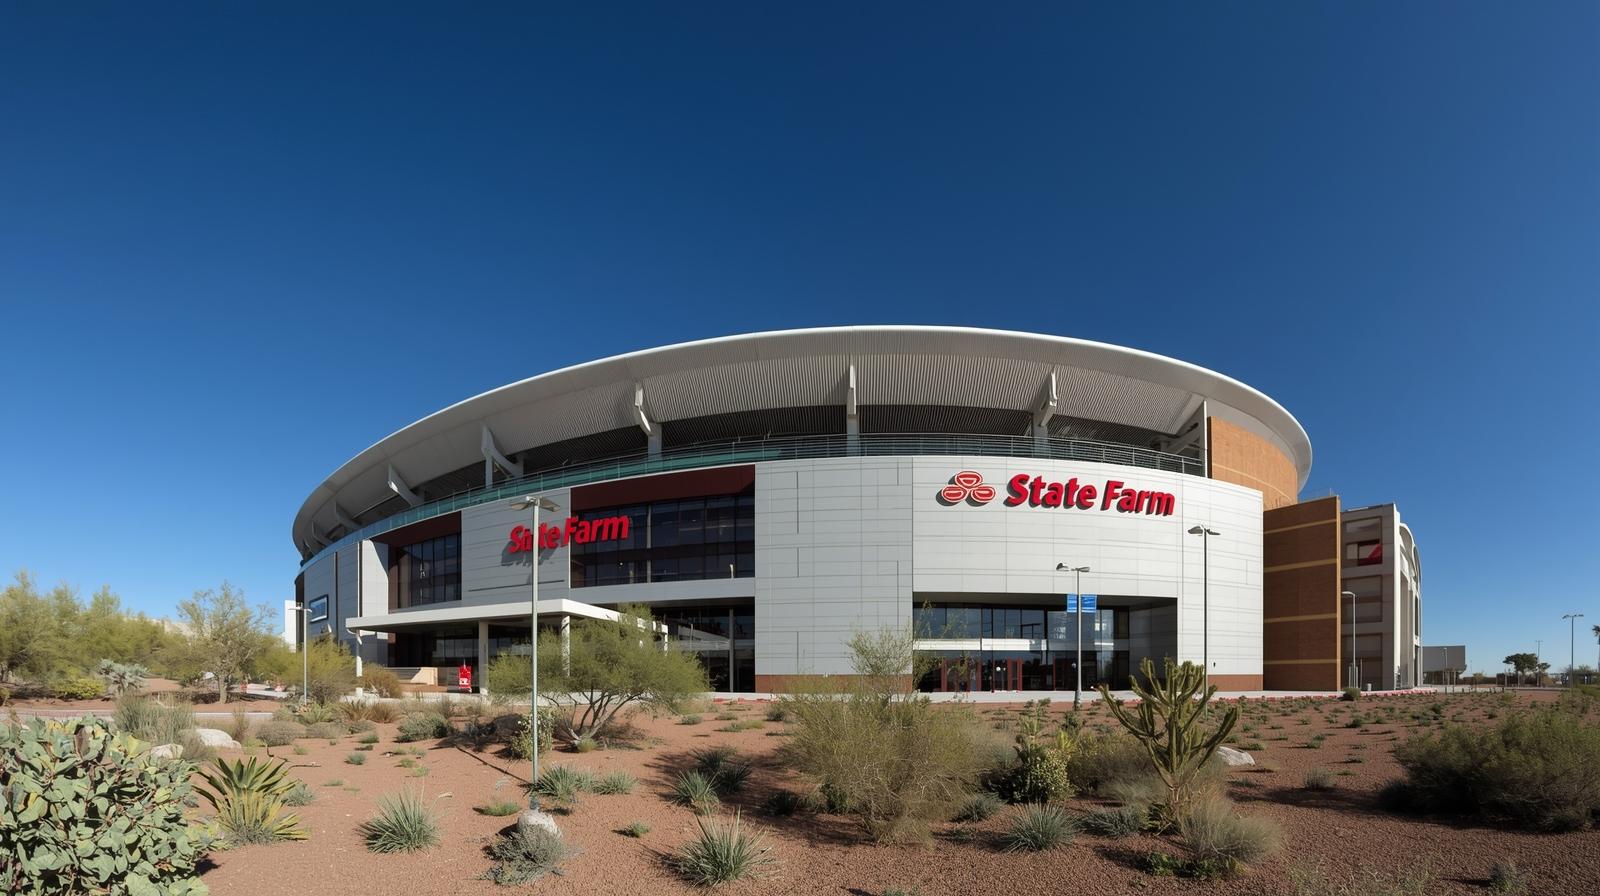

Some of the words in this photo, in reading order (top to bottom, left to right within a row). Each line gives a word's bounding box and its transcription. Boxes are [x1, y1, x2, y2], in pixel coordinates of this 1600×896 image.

[1005, 473, 1098, 508] State
[1101, 480, 1176, 515] Farm
[562, 515, 631, 546] Farm
